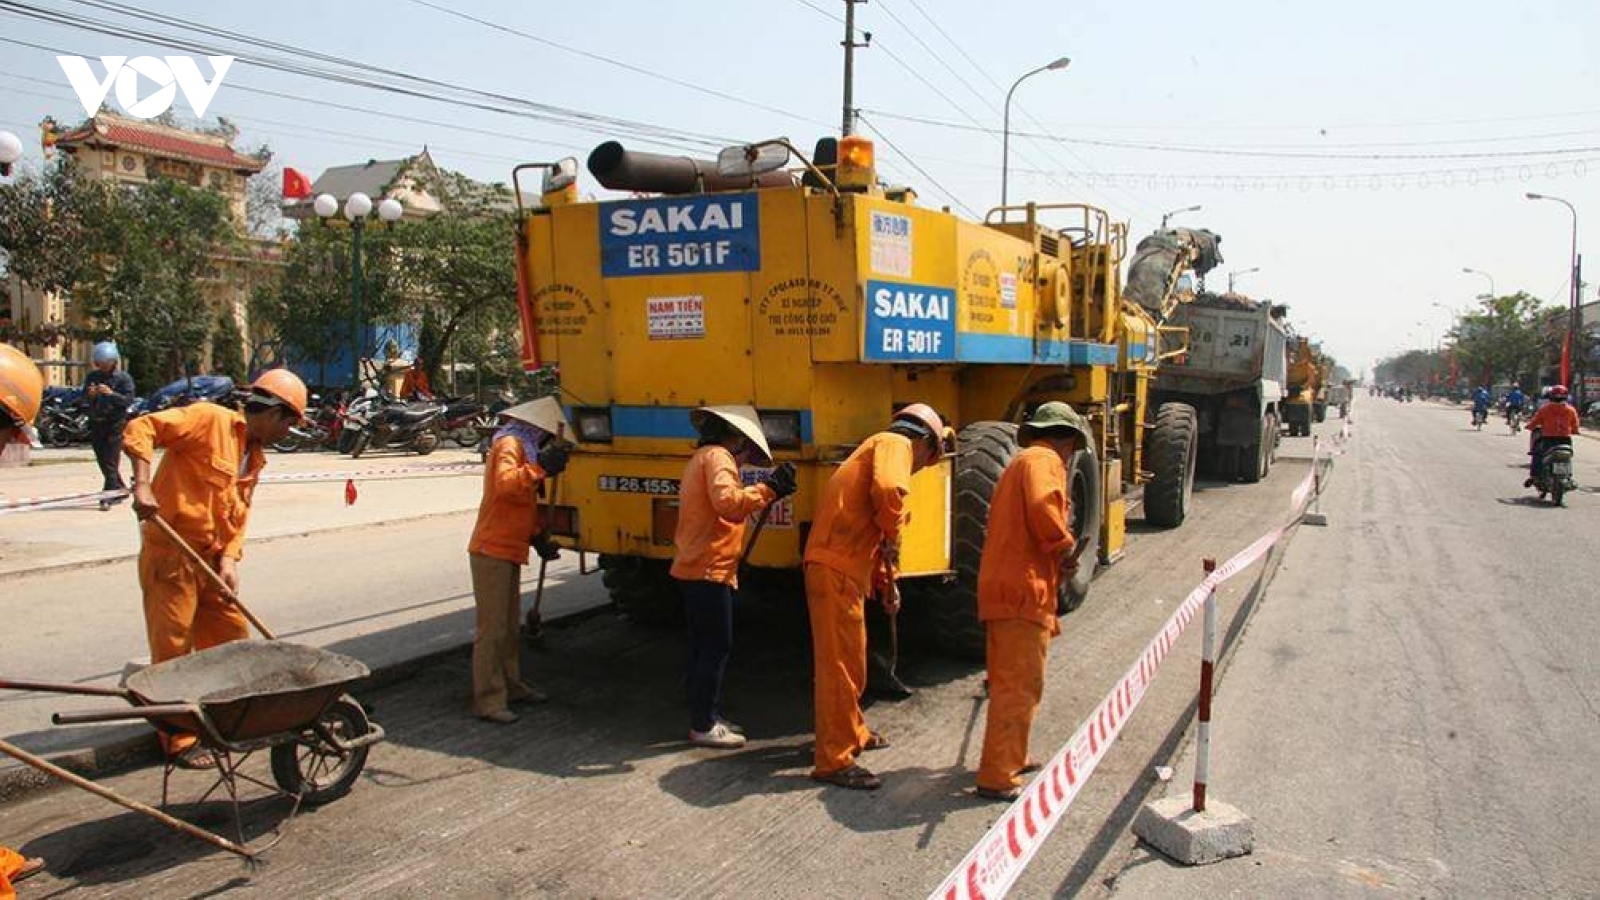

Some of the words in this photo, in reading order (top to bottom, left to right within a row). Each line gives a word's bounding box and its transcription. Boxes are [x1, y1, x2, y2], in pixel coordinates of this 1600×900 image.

[610, 202, 743, 235] SAKAI
[628, 243, 660, 269] ER
[650, 301, 675, 313] NAM
[874, 288, 949, 320] SAKAI
[883, 328, 903, 352] ER
[907, 330, 942, 354] 501F
